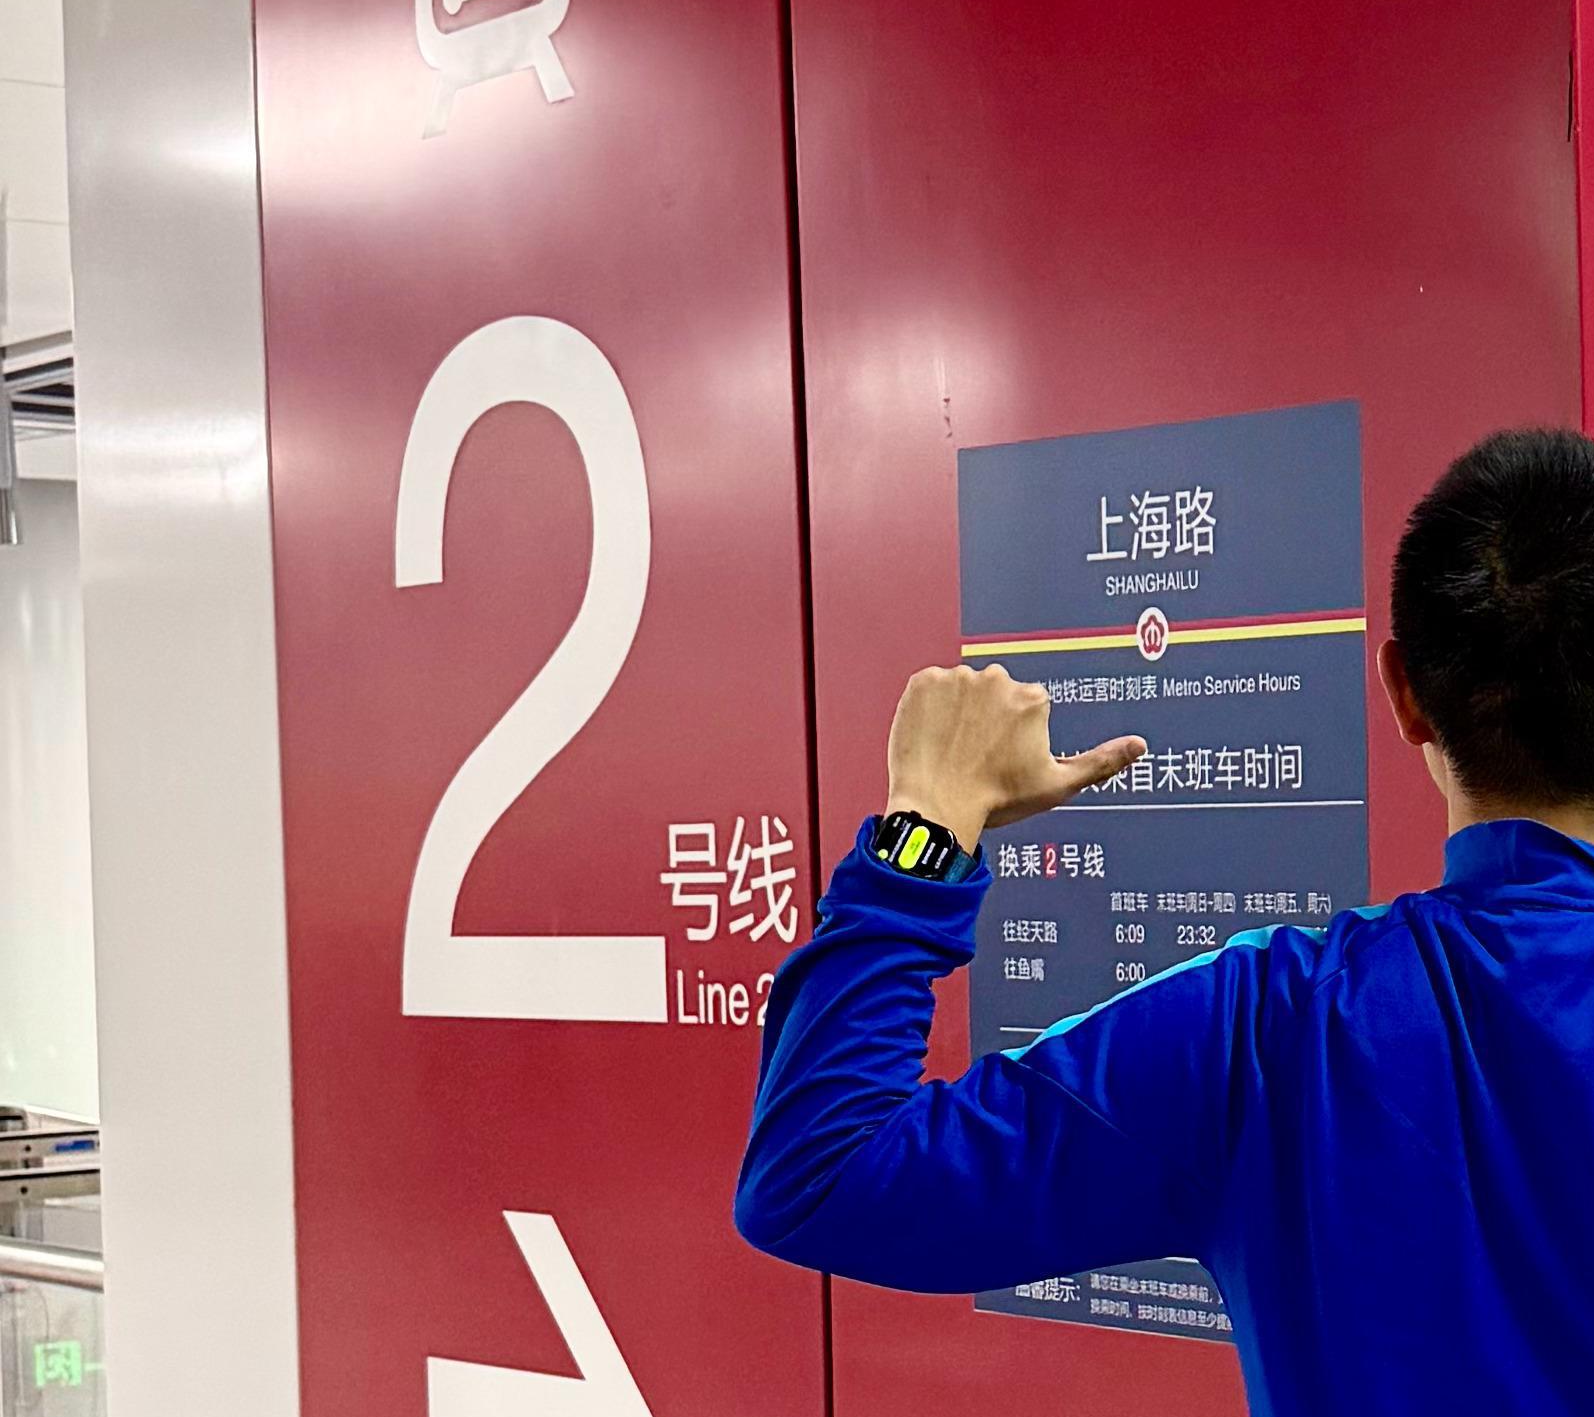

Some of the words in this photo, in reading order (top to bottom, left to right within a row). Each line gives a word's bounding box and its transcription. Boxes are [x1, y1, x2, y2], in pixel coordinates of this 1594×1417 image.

[1086, 485, 1217, 562] 上海路
[1105, 569, 1200, 597] SHANGHAILU
[395, 315, 667, 1024] 2
[1037, 675, 1158, 704] 地铁运营时刻表
[1162, 677, 1201, 698] Metro
[1203, 674, 1256, 697] Service
[1258, 672, 1302, 693] Hours
[998, 842, 1106, 880] 换乘2号线
[660, 815, 798, 943] 号线
[1109, 891, 1150, 913] 首班车
[1002, 919, 1058, 944] 往经天路
[1115, 924, 1146, 944] 6:09
[1176, 925, 1216, 945] 23:32
[1003, 956, 1045, 982] 往鱼嘴
[1115, 962, 1146, 982] 6:00
[676, 969, 750, 1027] Line
[756, 972, 776, 1027] 2
